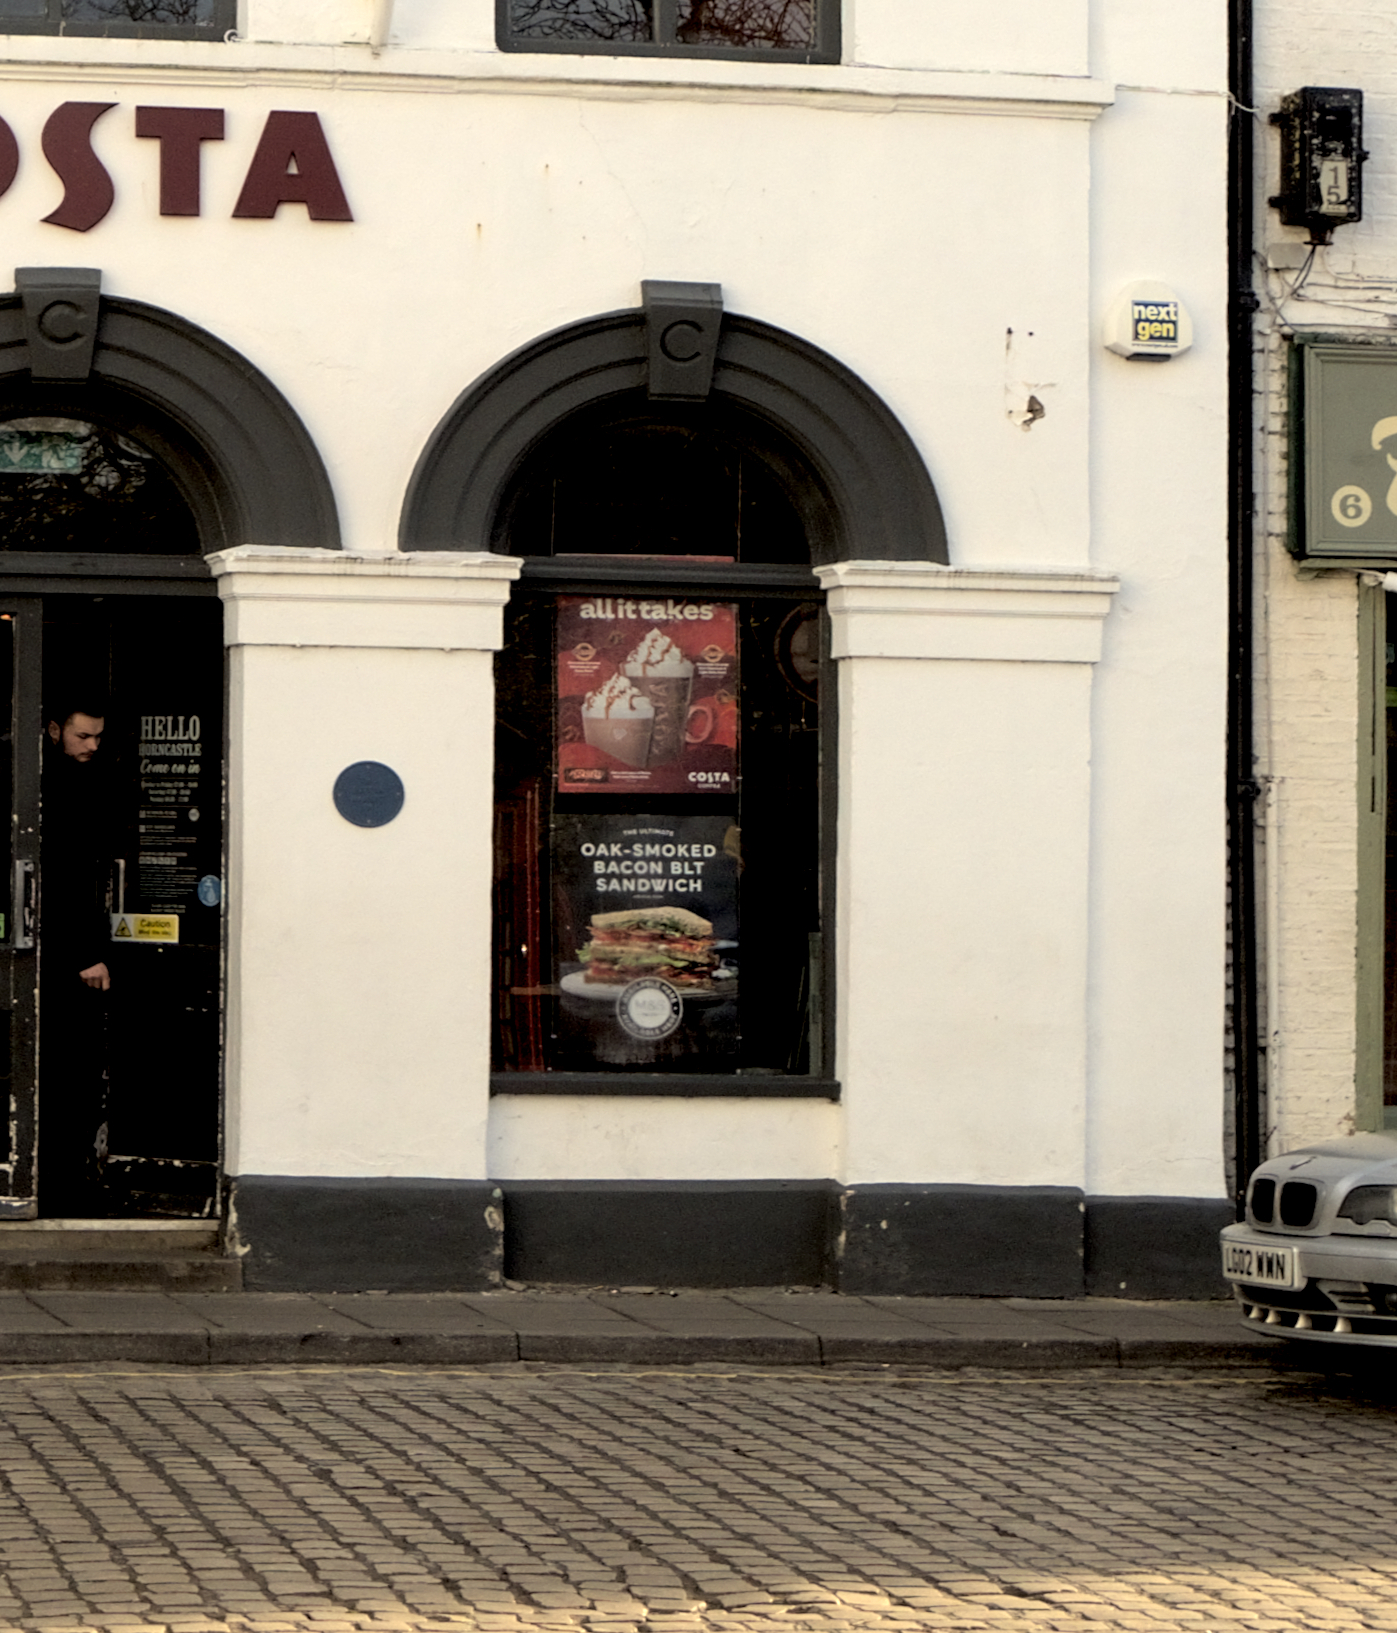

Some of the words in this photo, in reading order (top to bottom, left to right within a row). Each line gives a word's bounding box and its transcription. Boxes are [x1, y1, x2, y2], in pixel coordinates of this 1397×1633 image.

[1133, 303, 1177, 321] next
[1137, 321, 1174, 341] gen
[1339, 494, 1363, 520] 6
[140, 715, 201, 741] HELLO
[139, 743, 202, 756] HORNCASTLE
[140, 759, 170, 774] Come
[171, 763, 186, 774] on
[187, 759, 201, 774] in
[688, 772, 730, 783] COSTA
[639, 828, 674, 837] ULTIMATE
[580, 843, 716, 857] OAK-SMOKED
[593, 860, 663, 874] BACON
[670, 861, 705, 875] BLT
[596, 878, 702, 892] SANDWICH
[140, 918, 171, 929] Caution
[1256, 1251, 1286, 1280] WWN
